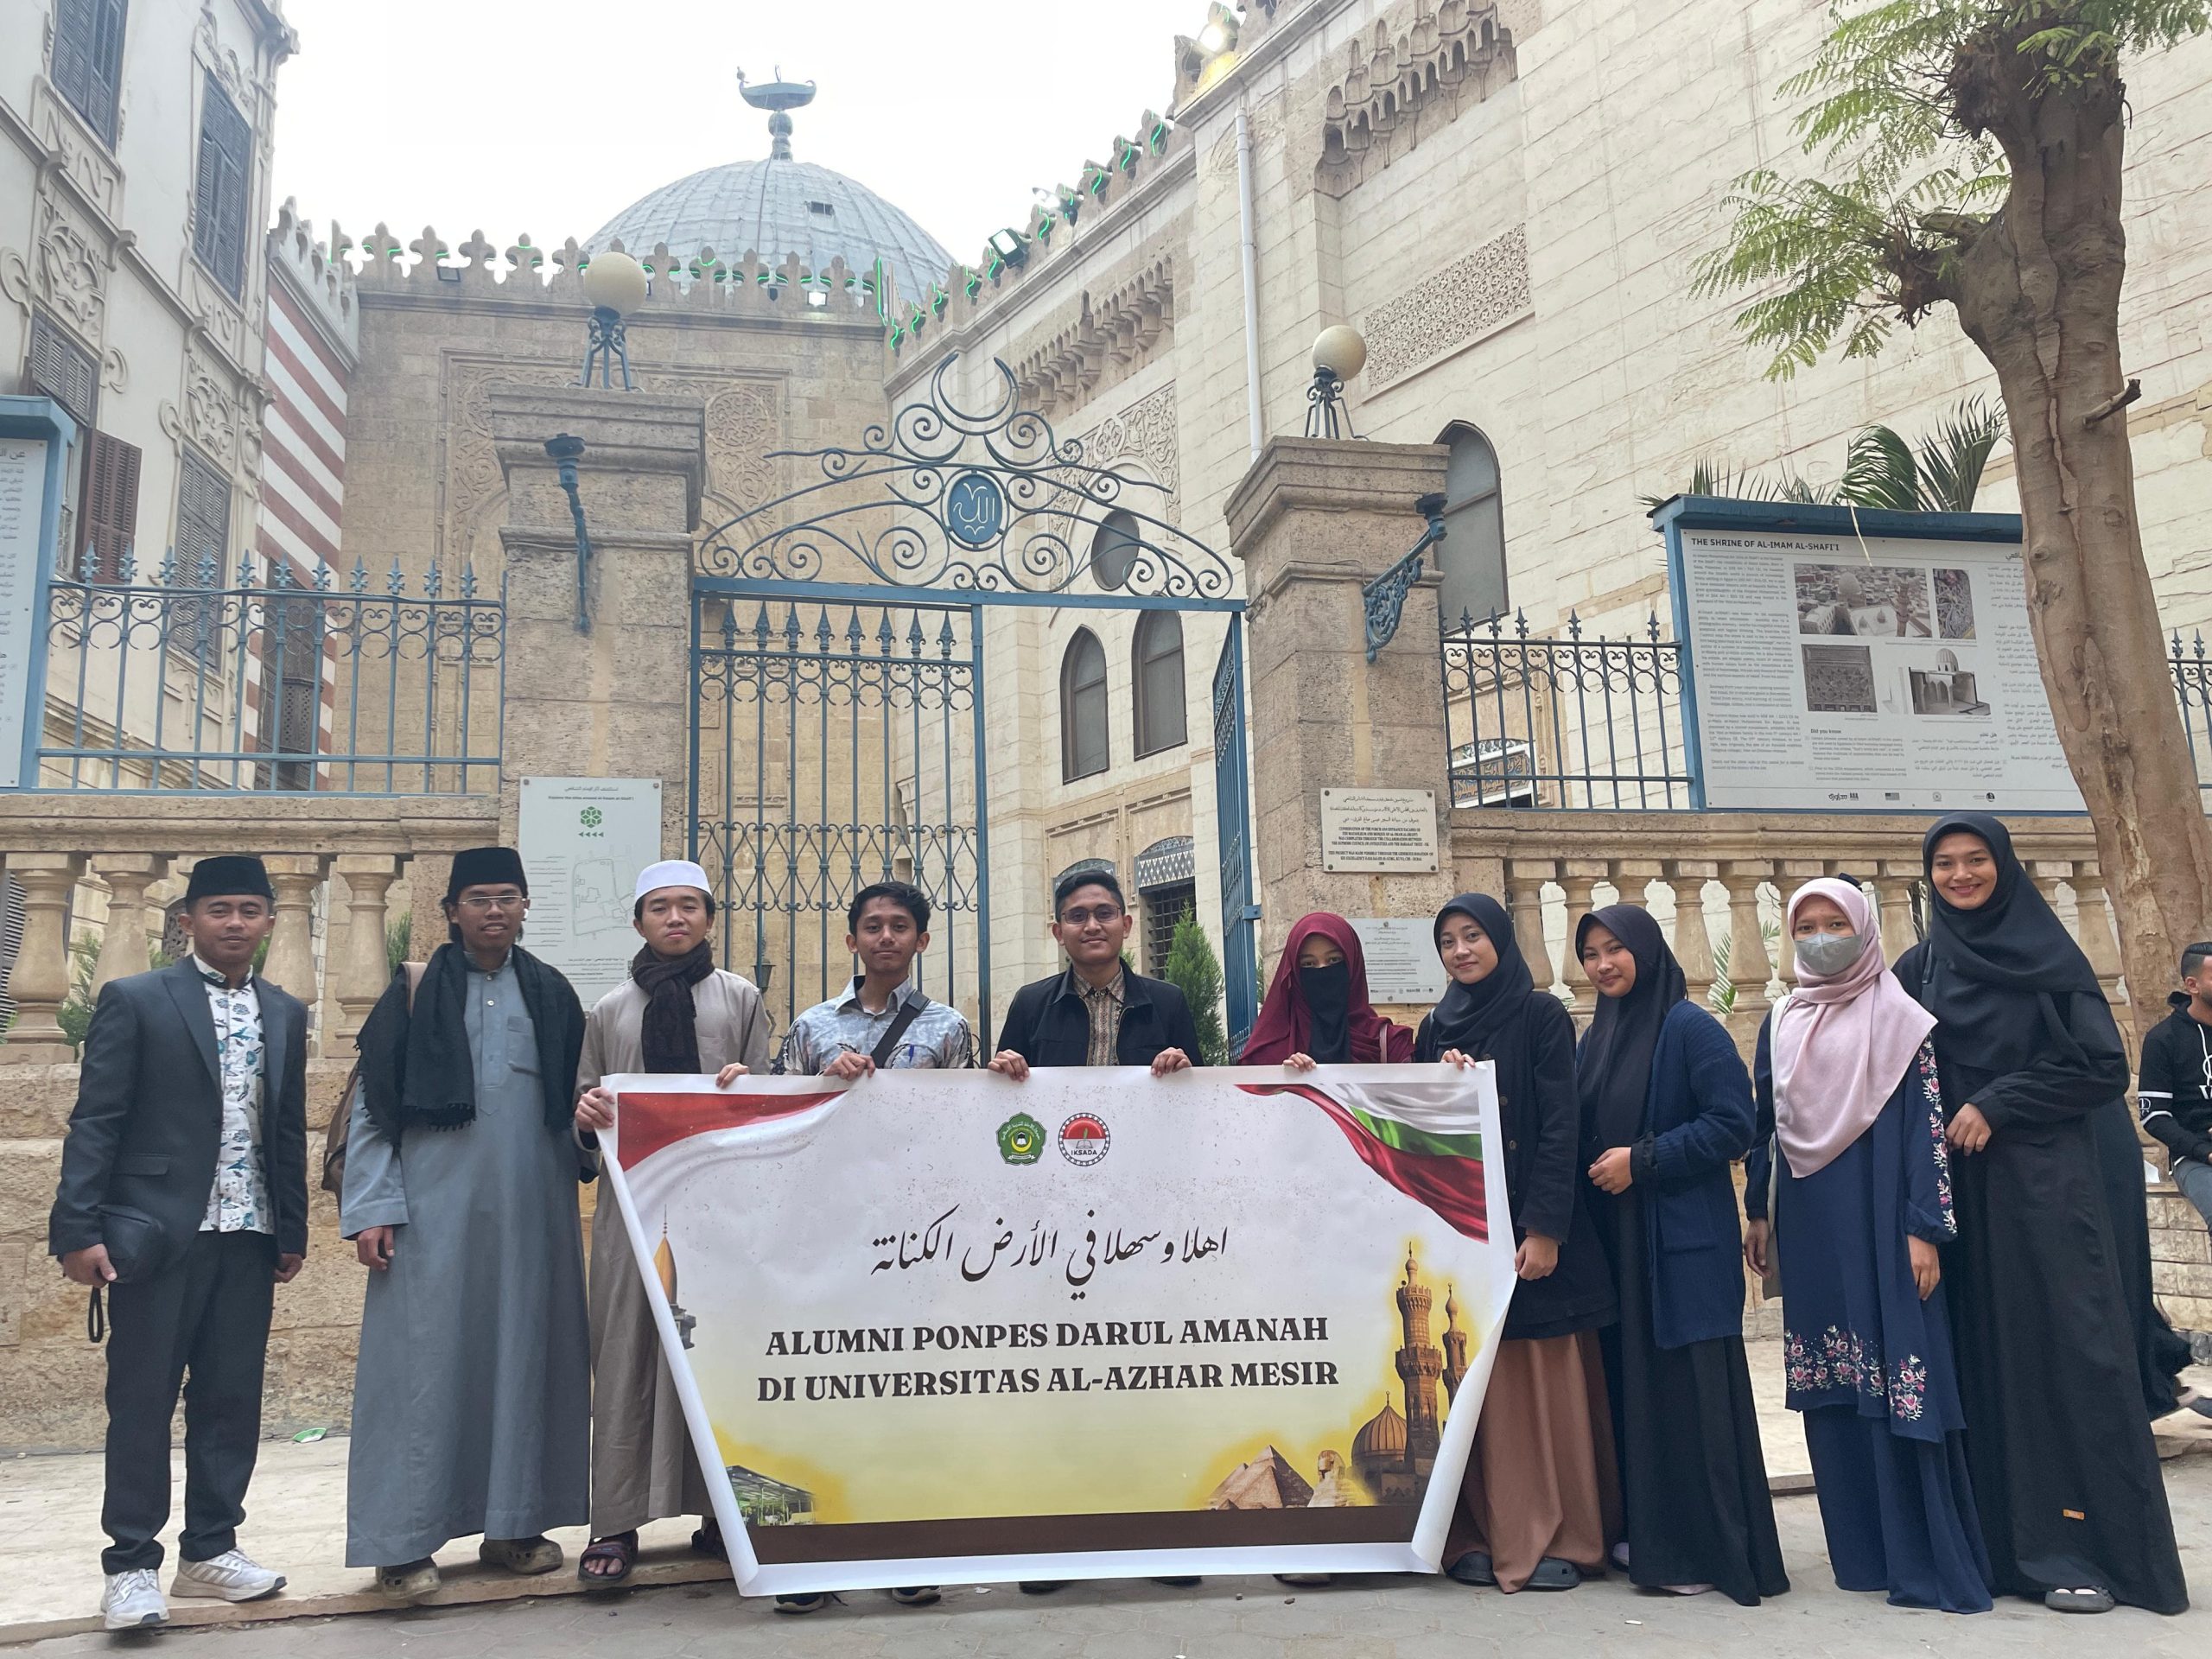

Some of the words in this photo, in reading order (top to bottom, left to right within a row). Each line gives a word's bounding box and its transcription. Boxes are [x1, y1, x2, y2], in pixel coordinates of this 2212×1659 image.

[1691, 537, 1708, 546] THE
[1710, 538, 1742, 547] SHRINE
[1757, 541, 1793, 550] AL-IMAM
[870, 1203, 961, 1275] الكنانة
[961, 1217, 1058, 1282] الأرض
[1065, 1209, 1096, 1301] في
[766, 1327, 905, 1356] ALUMNI
[912, 1323, 1048, 1351] PONPES
[1056, 1320, 1173, 1347] DARUL
[1179, 1317, 1329, 1344] AMANAH
[758, 1376, 796, 1402] DI
[804, 1368, 1040, 1401] UNIVERSITAS
[1046, 1363, 1224, 1392] AL-AZHAR
[1230, 1361, 1339, 1387] MESIR
